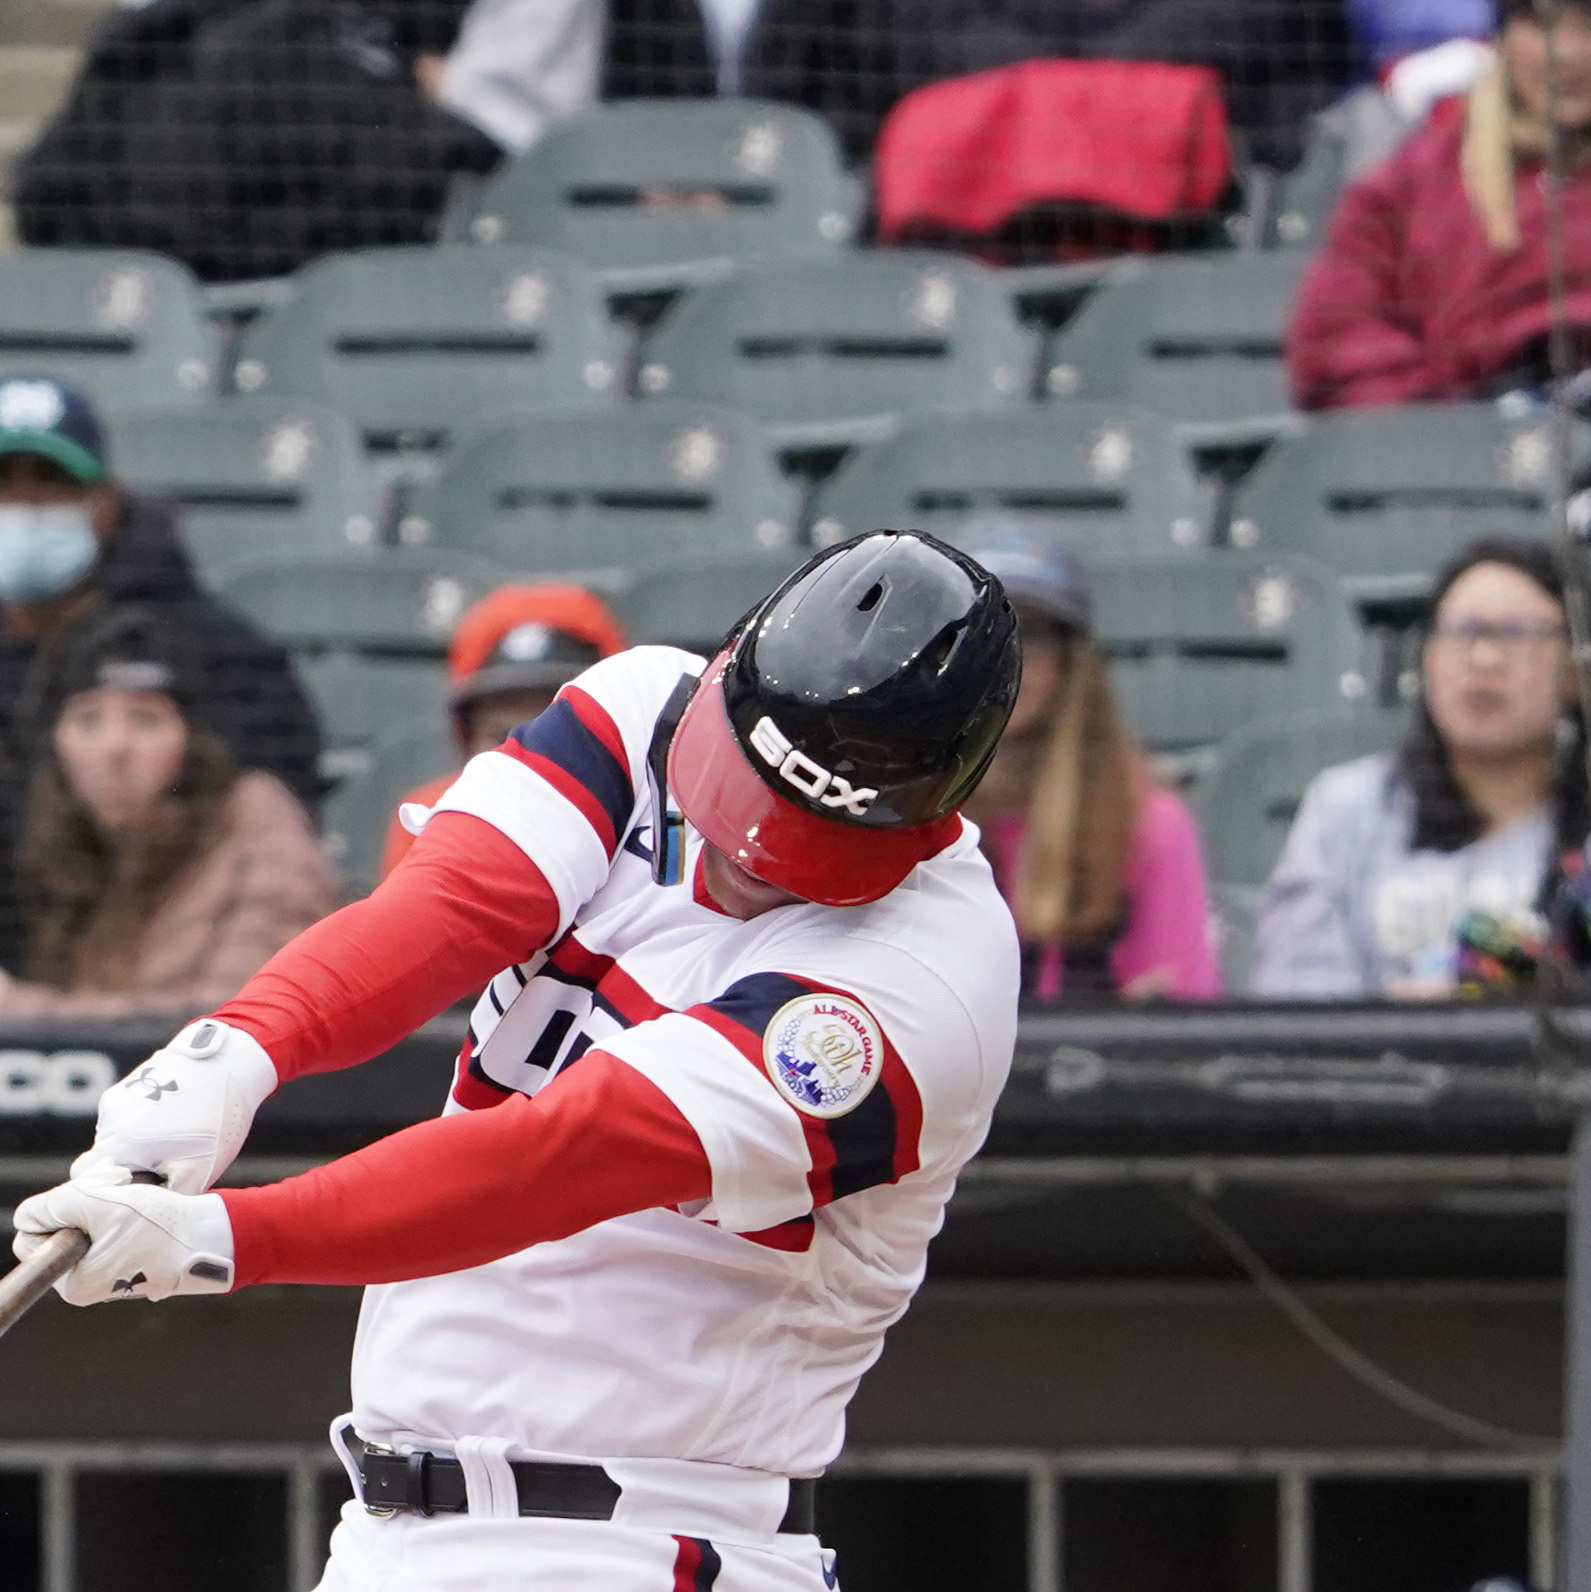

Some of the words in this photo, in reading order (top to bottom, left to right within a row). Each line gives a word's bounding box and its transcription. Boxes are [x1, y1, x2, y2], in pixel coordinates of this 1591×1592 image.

[749, 715, 879, 816] SOX
[469, 930, 628, 1098] SO
[840, 1009, 867, 1037] STAR
[861, 1036, 874, 1076] GAME
